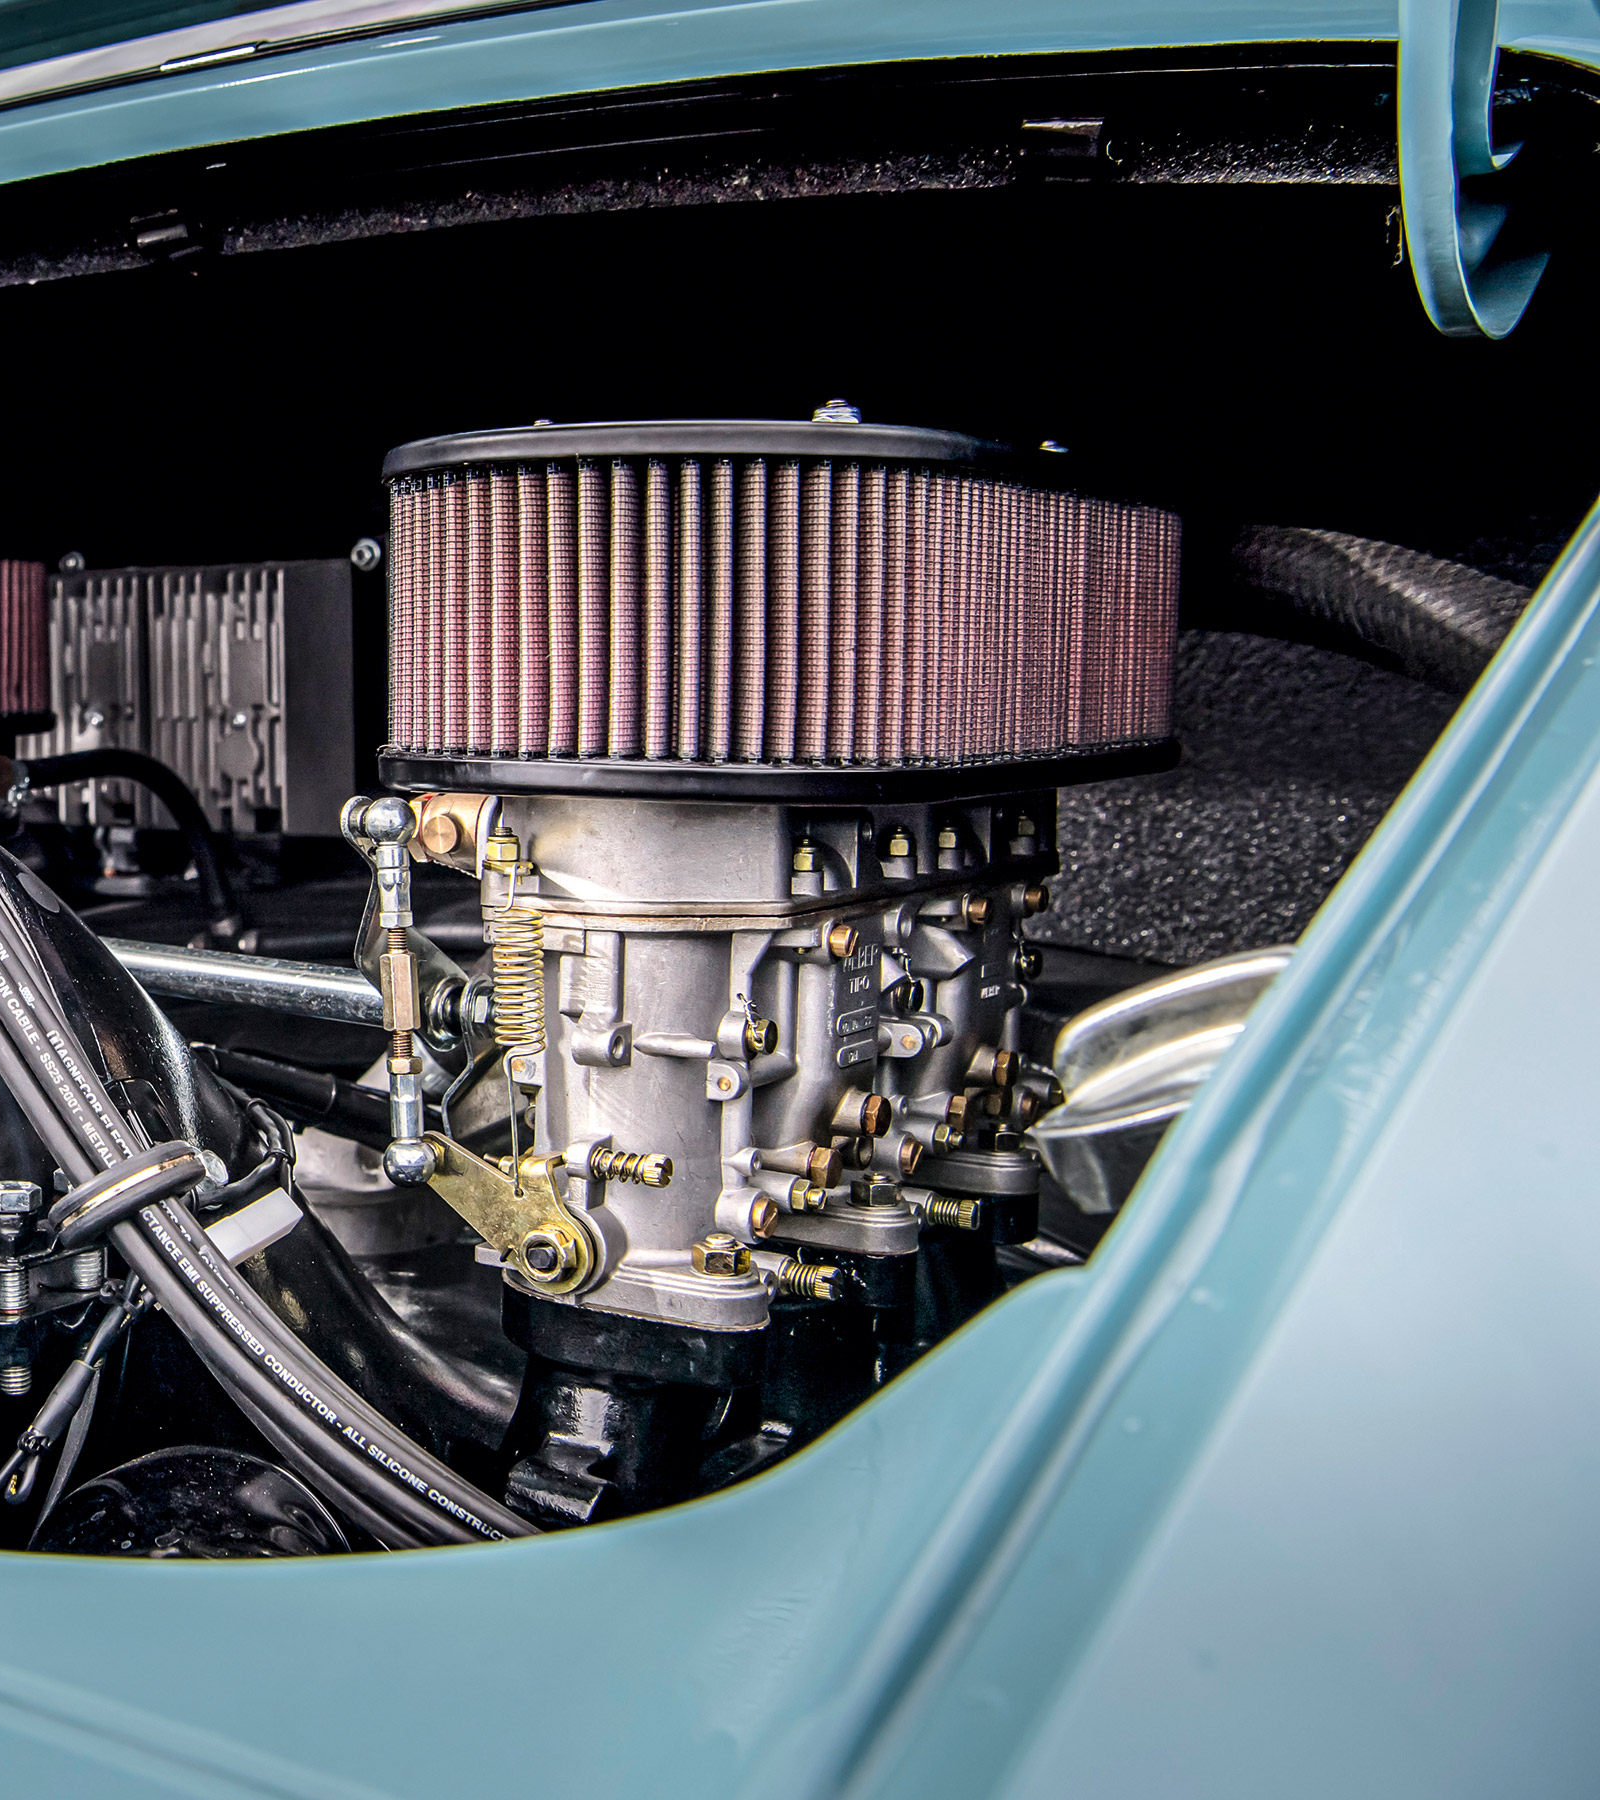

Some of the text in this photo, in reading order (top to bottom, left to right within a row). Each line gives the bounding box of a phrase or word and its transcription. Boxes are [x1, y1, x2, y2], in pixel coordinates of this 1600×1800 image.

[7, 997, 41, 1045] CABLE
[39, 1052, 64, 1086] SS25
[178, 1256, 200, 1284] EMI
[196, 1278, 266, 1357] SUPPRESSED
[264, 1353, 338, 1425] CONDUCTOR
[342, 1426, 367, 1451] ALL
[367, 1444, 428, 1494] SILICONE
